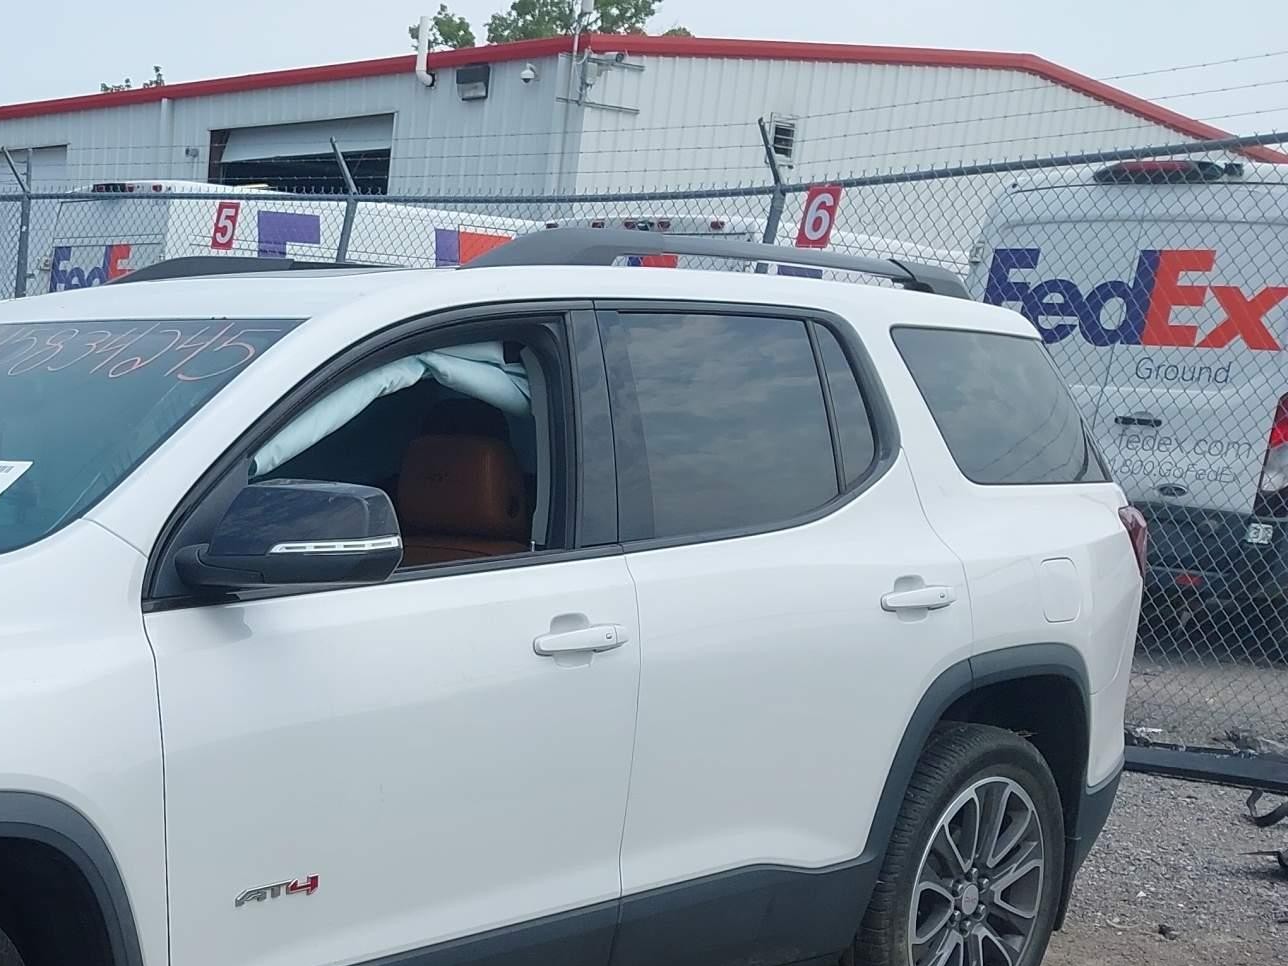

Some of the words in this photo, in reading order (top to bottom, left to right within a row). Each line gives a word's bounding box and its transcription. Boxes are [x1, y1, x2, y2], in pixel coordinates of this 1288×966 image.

[215, 208, 236, 244] 5
[804, 193, 834, 240] 6
[49, 244, 136, 292] FedE
[983, 247, 1288, 351] FedEx
[1135, 357, 1233, 385] Ground
[234, 874, 320, 907] AT4
